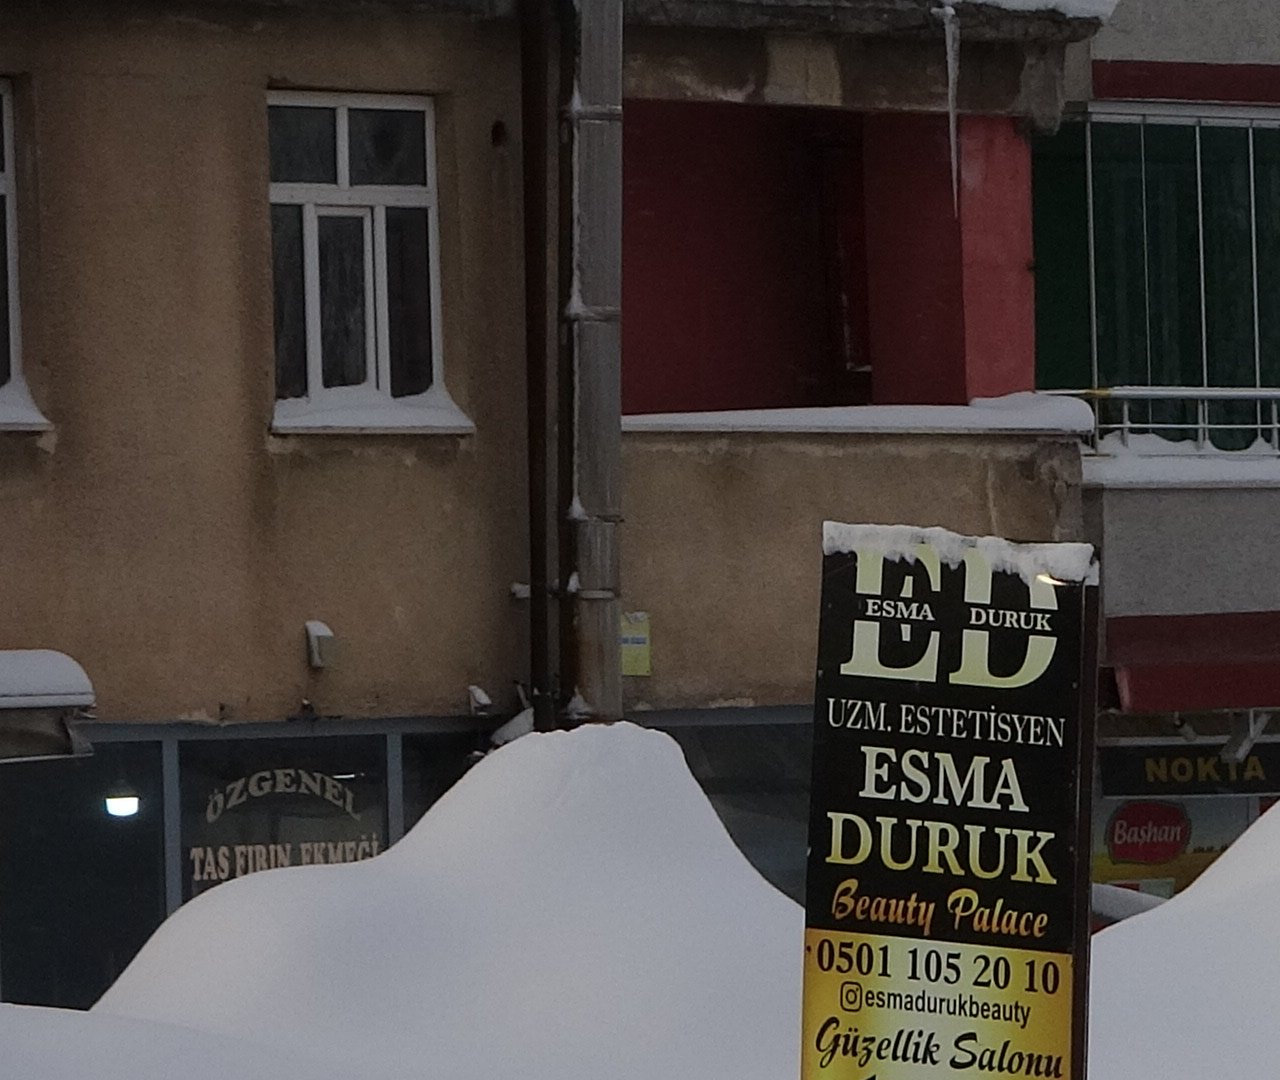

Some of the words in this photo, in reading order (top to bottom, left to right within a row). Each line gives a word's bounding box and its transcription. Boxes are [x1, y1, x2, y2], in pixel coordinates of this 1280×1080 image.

[865, 599, 935, 621] ESMA
[969, 607, 1052, 631] DURUK
[827, 698, 892, 732] UZM.
[899, 704, 1066, 747] ESTETİSYEN
[205, 768, 362, 824] ÖZGENEL
[858, 745, 1030, 812] ESMA
[235, 843, 293, 879] FIRIN
[825, 811, 1058, 885] DURUK
[832, 878, 936, 936] Beauty
[947, 888, 1048, 938] Palace
[816, 939, 892, 978] 0501
[907, 947, 962, 984] 105
[972, 954, 1011, 990] 20
[1024, 959, 1061, 995] 10
[864, 990, 1031, 1029] esmadurukbeauty
[815, 1016, 941, 1068] Güzellik
[949, 1032, 1063, 1079] Salonu
